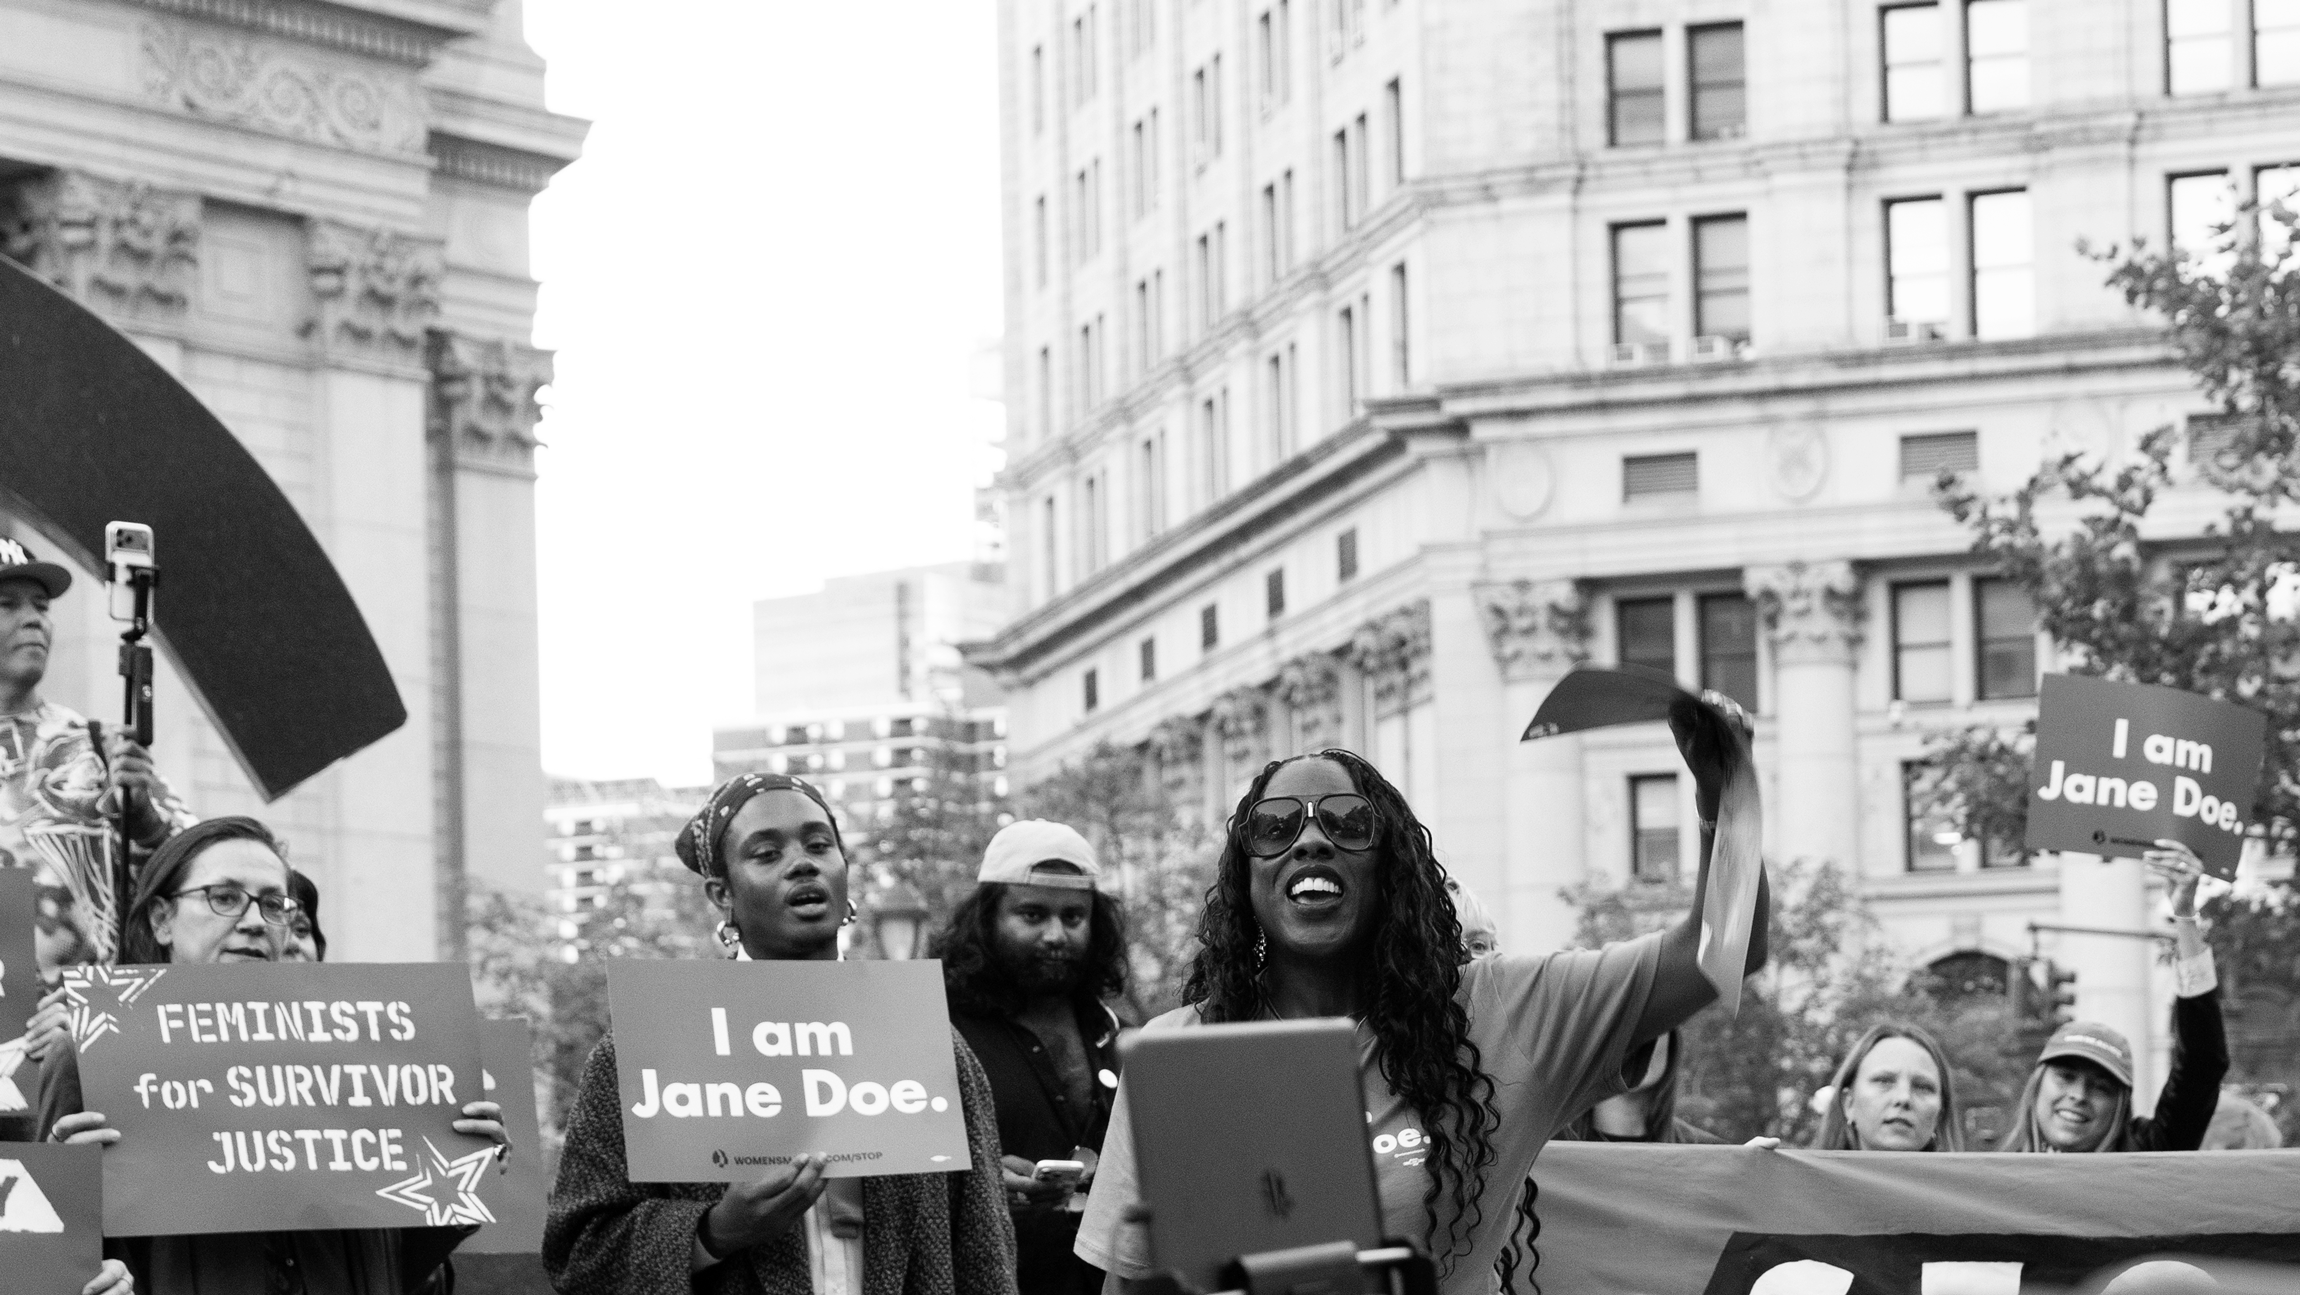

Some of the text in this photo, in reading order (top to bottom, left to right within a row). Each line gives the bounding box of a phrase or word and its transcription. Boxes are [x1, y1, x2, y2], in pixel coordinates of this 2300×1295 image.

[2112, 717, 2213, 774] I am
[2037, 759, 2244, 836] Jane Doe.
[156, 1000, 416, 1044] FEMINISTS
[710, 1007, 854, 1057] I am
[133, 1063, 457, 1110] for SURVIVOR
[631, 1068, 949, 1118] Jane Doe.
[207, 1127, 408, 1174] JUSTICE
[1372, 1127, 1431, 1154] oe.
